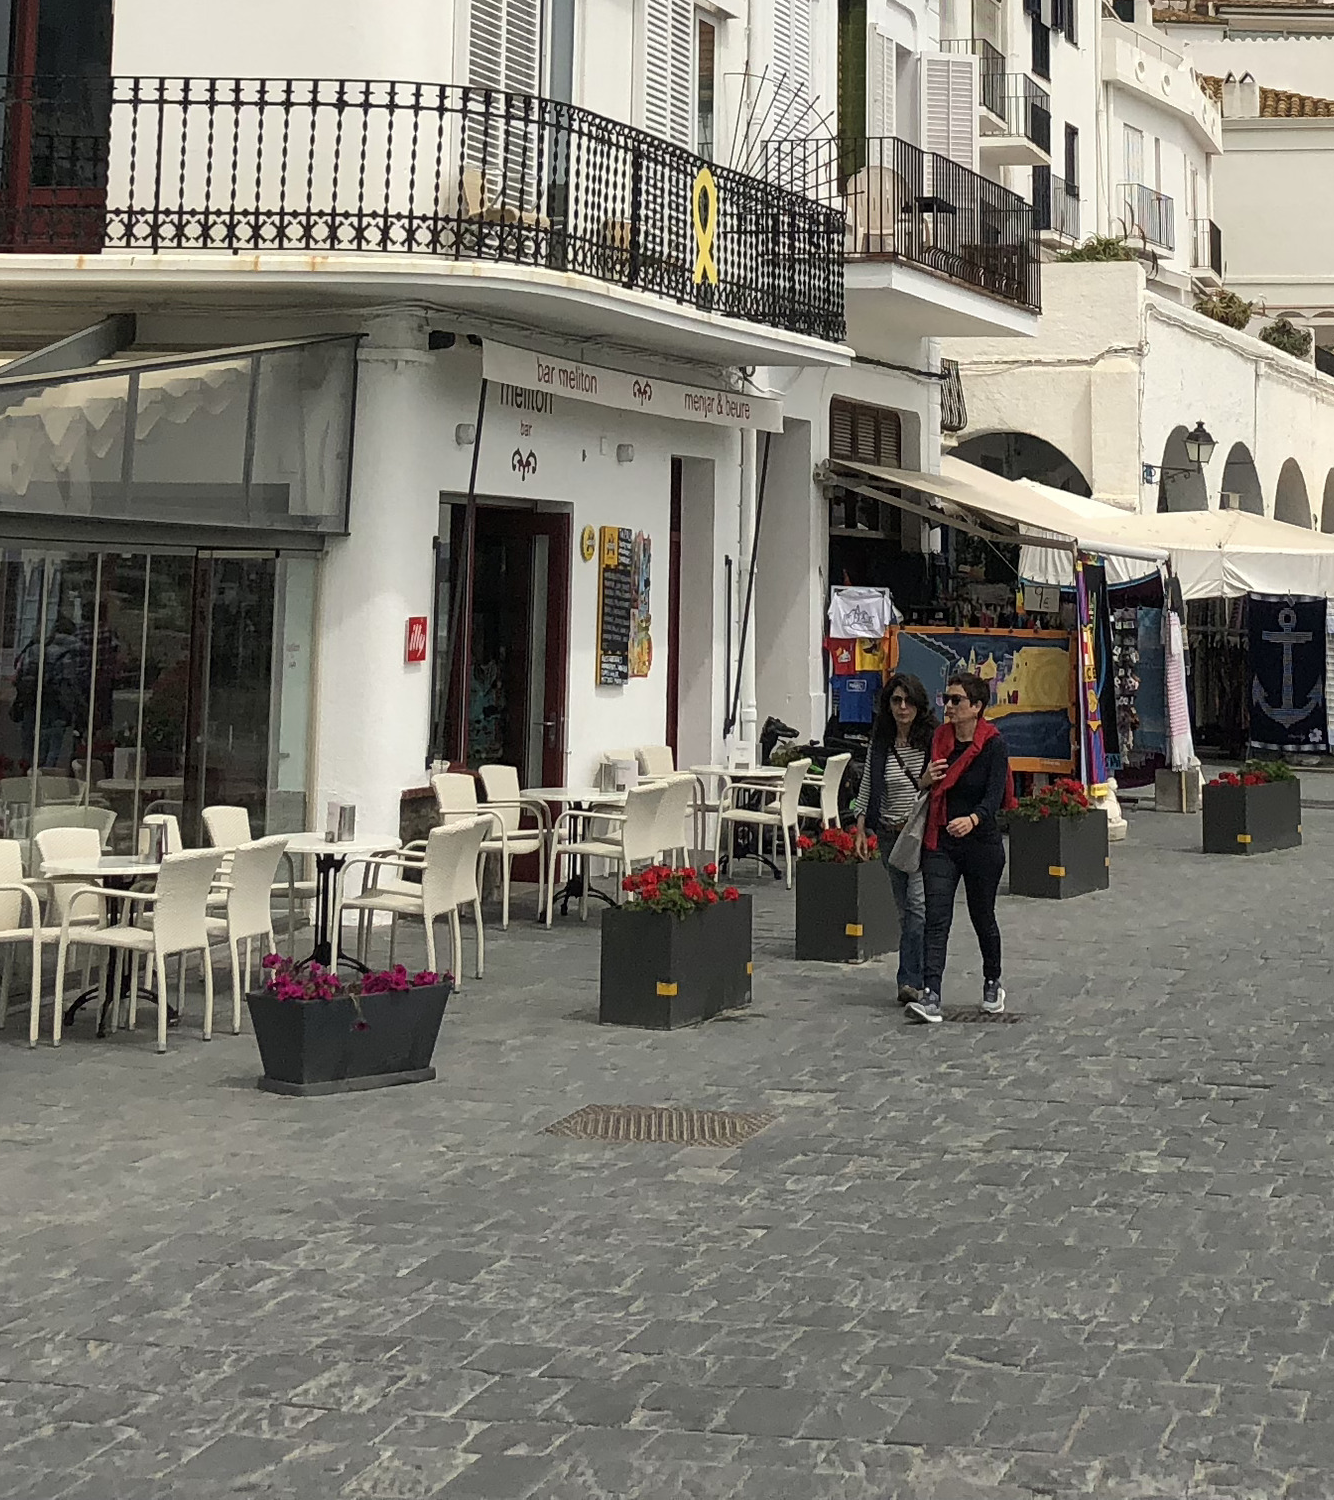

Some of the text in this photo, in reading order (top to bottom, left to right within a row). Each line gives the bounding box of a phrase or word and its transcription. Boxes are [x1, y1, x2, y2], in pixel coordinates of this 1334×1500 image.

[536, 356, 598, 395] bar meliton
[684, 392, 751, 420] menjar & beure
[519, 419, 533, 438] bar
[409, 623, 426, 658] illy
